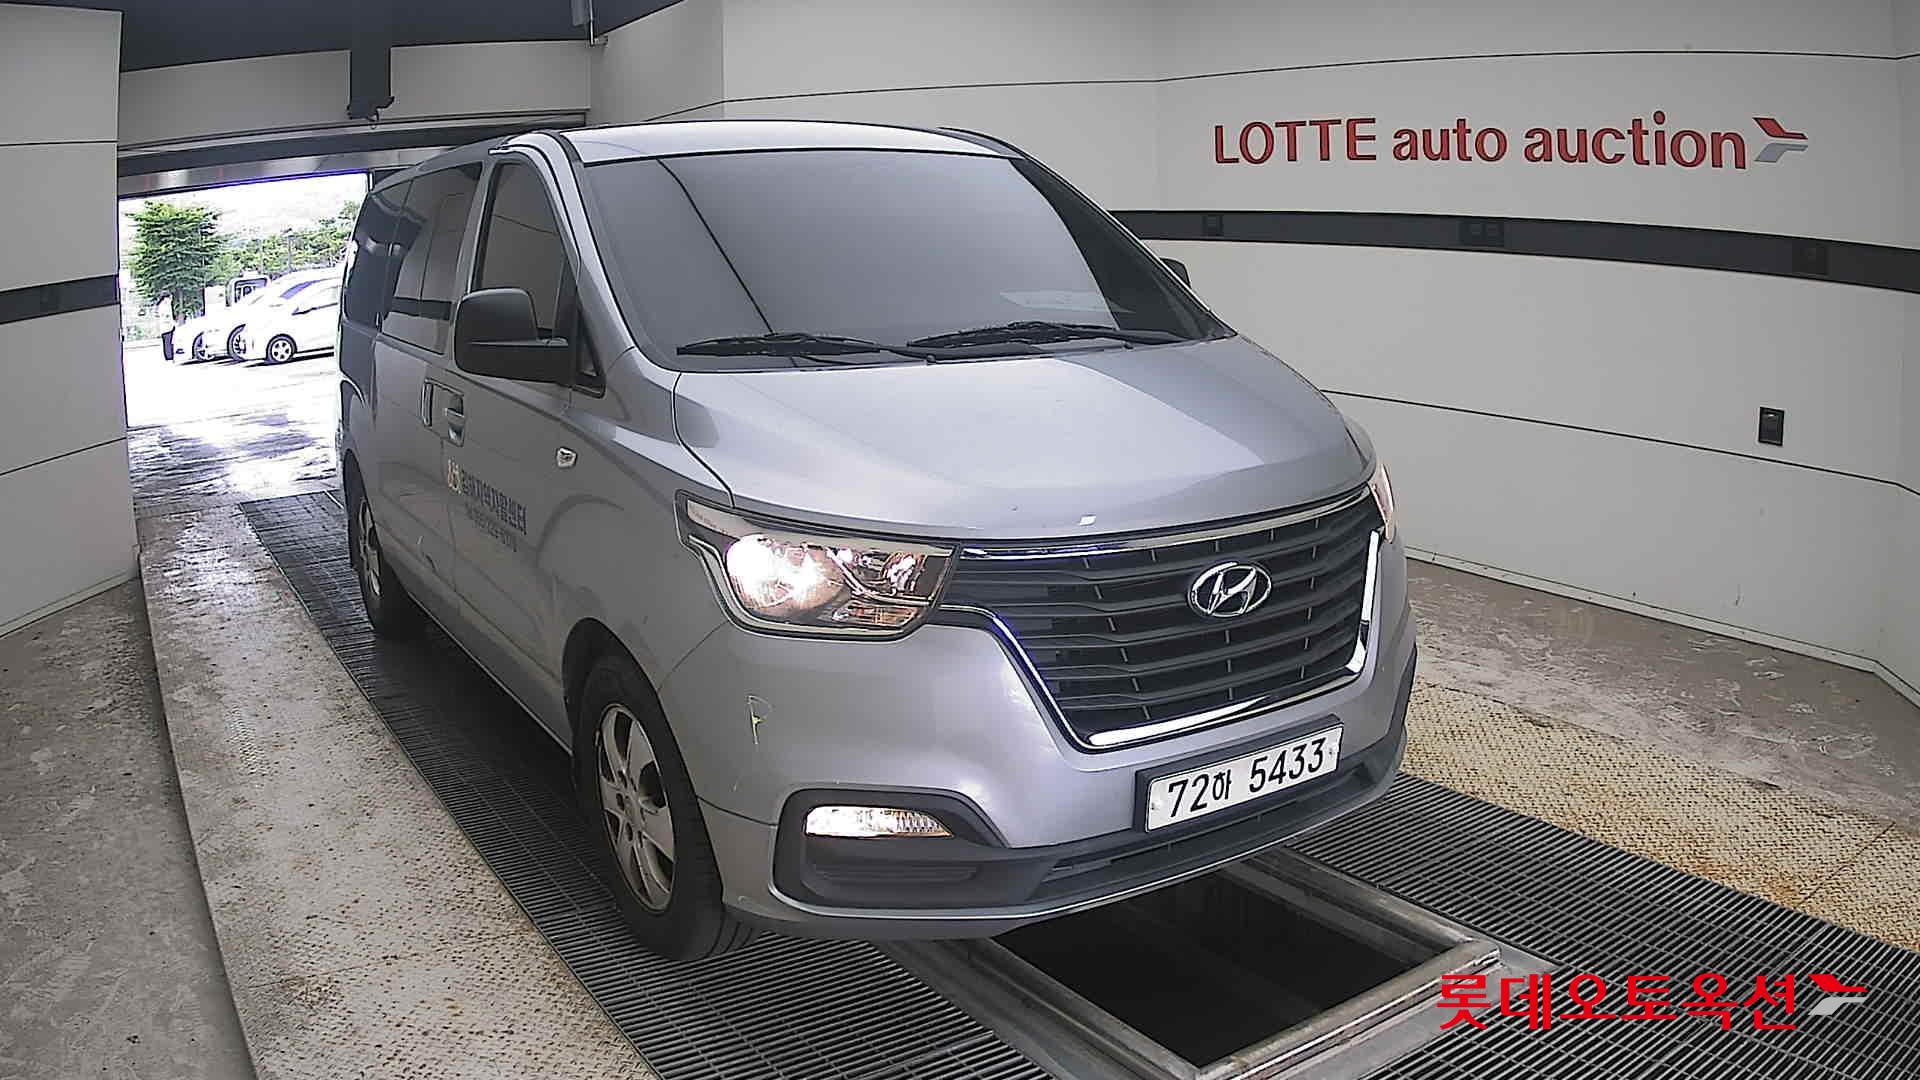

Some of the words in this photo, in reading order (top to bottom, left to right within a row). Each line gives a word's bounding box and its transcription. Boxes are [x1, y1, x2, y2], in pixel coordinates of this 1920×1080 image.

[1214, 117, 1377, 165] LOTTE
[1392, 117, 1509, 163] auto
[1523, 110, 1748, 170] auction
[1167, 768, 1232, 818] 72하
[1249, 737, 1326, 793] 5433
